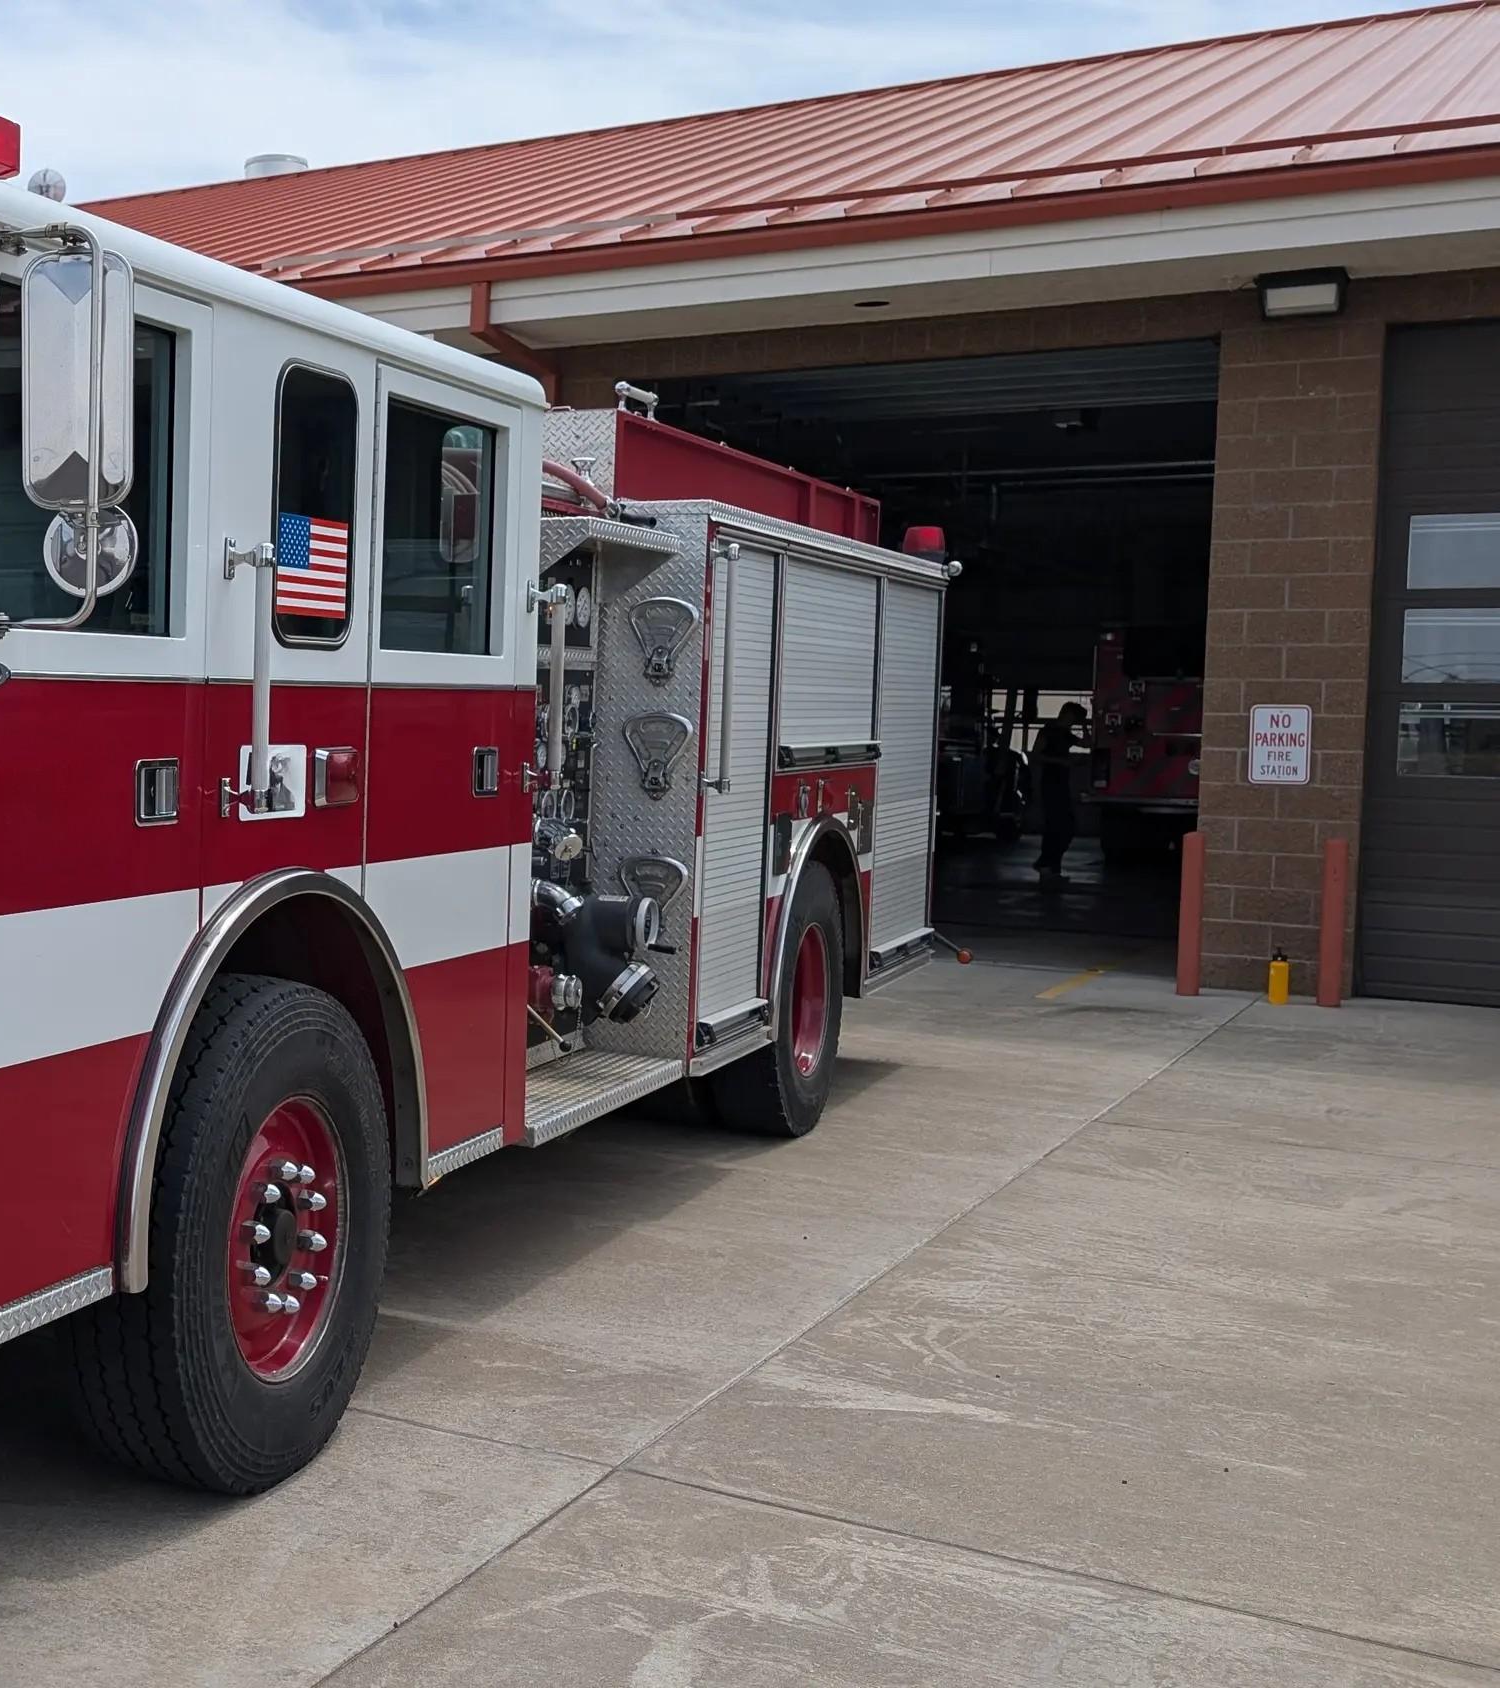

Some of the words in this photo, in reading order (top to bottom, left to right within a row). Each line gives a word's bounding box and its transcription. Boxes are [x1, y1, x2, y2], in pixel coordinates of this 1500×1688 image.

[1270, 713, 1291, 728] NO
[1255, 732, 1305, 747] PARKING
[1267, 751, 1291, 761] FIRE
[1260, 765, 1298, 776] STATION
